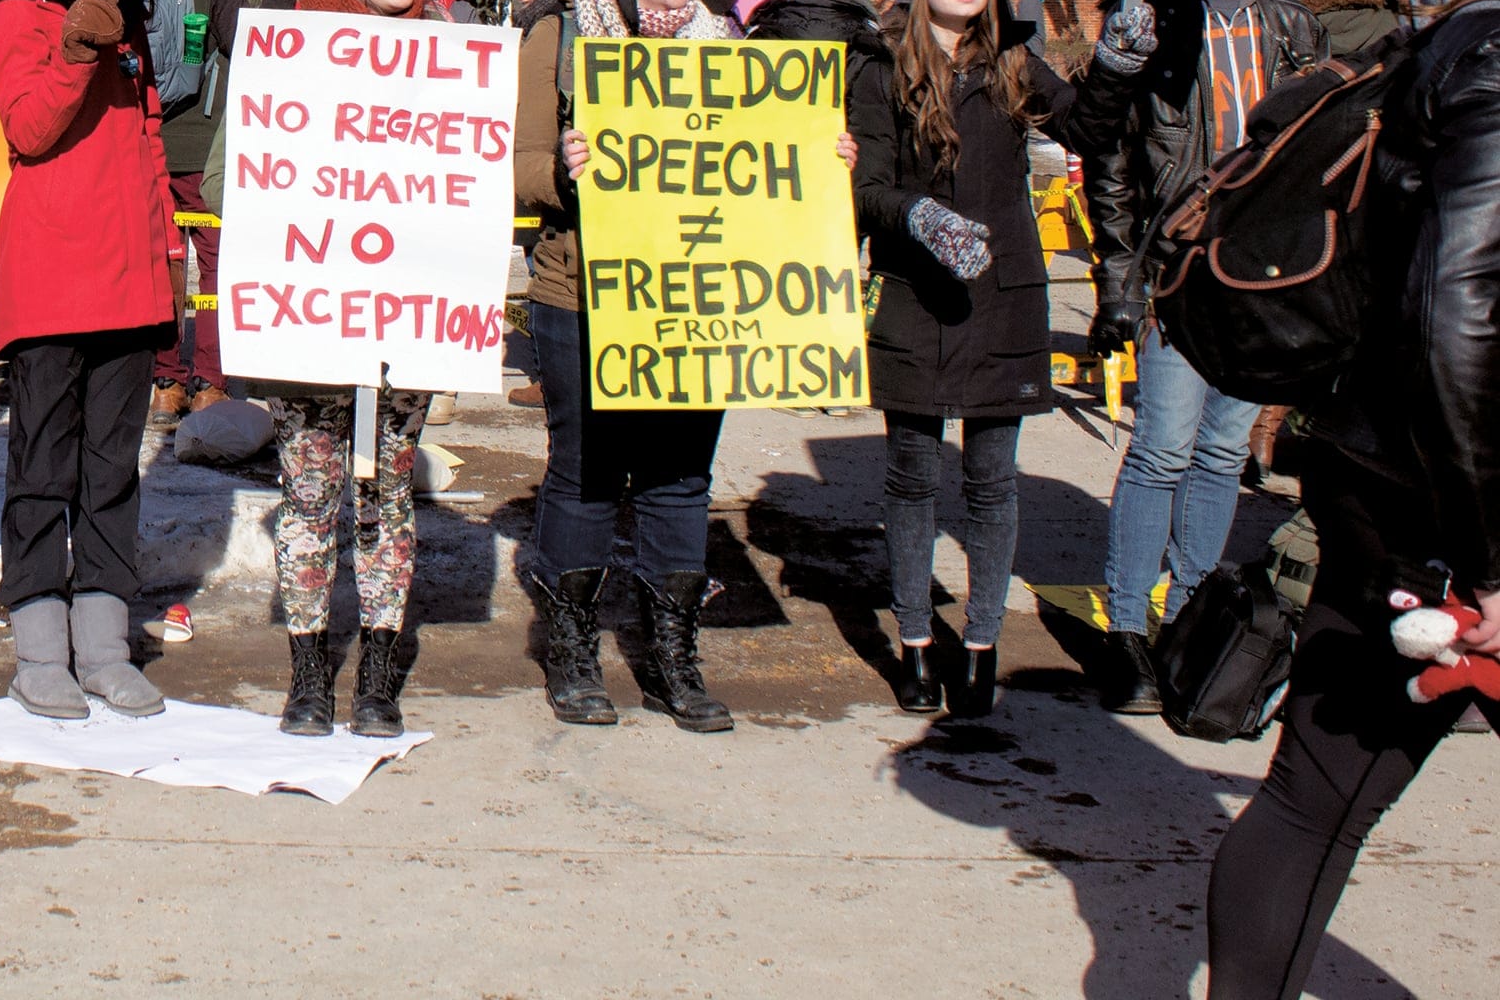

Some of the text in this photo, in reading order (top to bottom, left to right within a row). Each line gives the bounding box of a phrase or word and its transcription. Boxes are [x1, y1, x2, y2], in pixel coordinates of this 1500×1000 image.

[246, 25, 502, 88] NO GUILT
[584, 42, 840, 109] FREEDOM
[240, 94, 510, 162] NO REGRETS
[685, 113, 723, 130] OF
[237, 153, 476, 207] NO SHAME
[592, 129, 802, 201] SPEECH
[285, 219, 395, 264] NO
[231, 282, 503, 352] EXCEPTIONS
[588, 259, 856, 316] FREEDOM
[655, 318, 762, 342] FROM
[596, 344, 862, 403] CRITICISM
